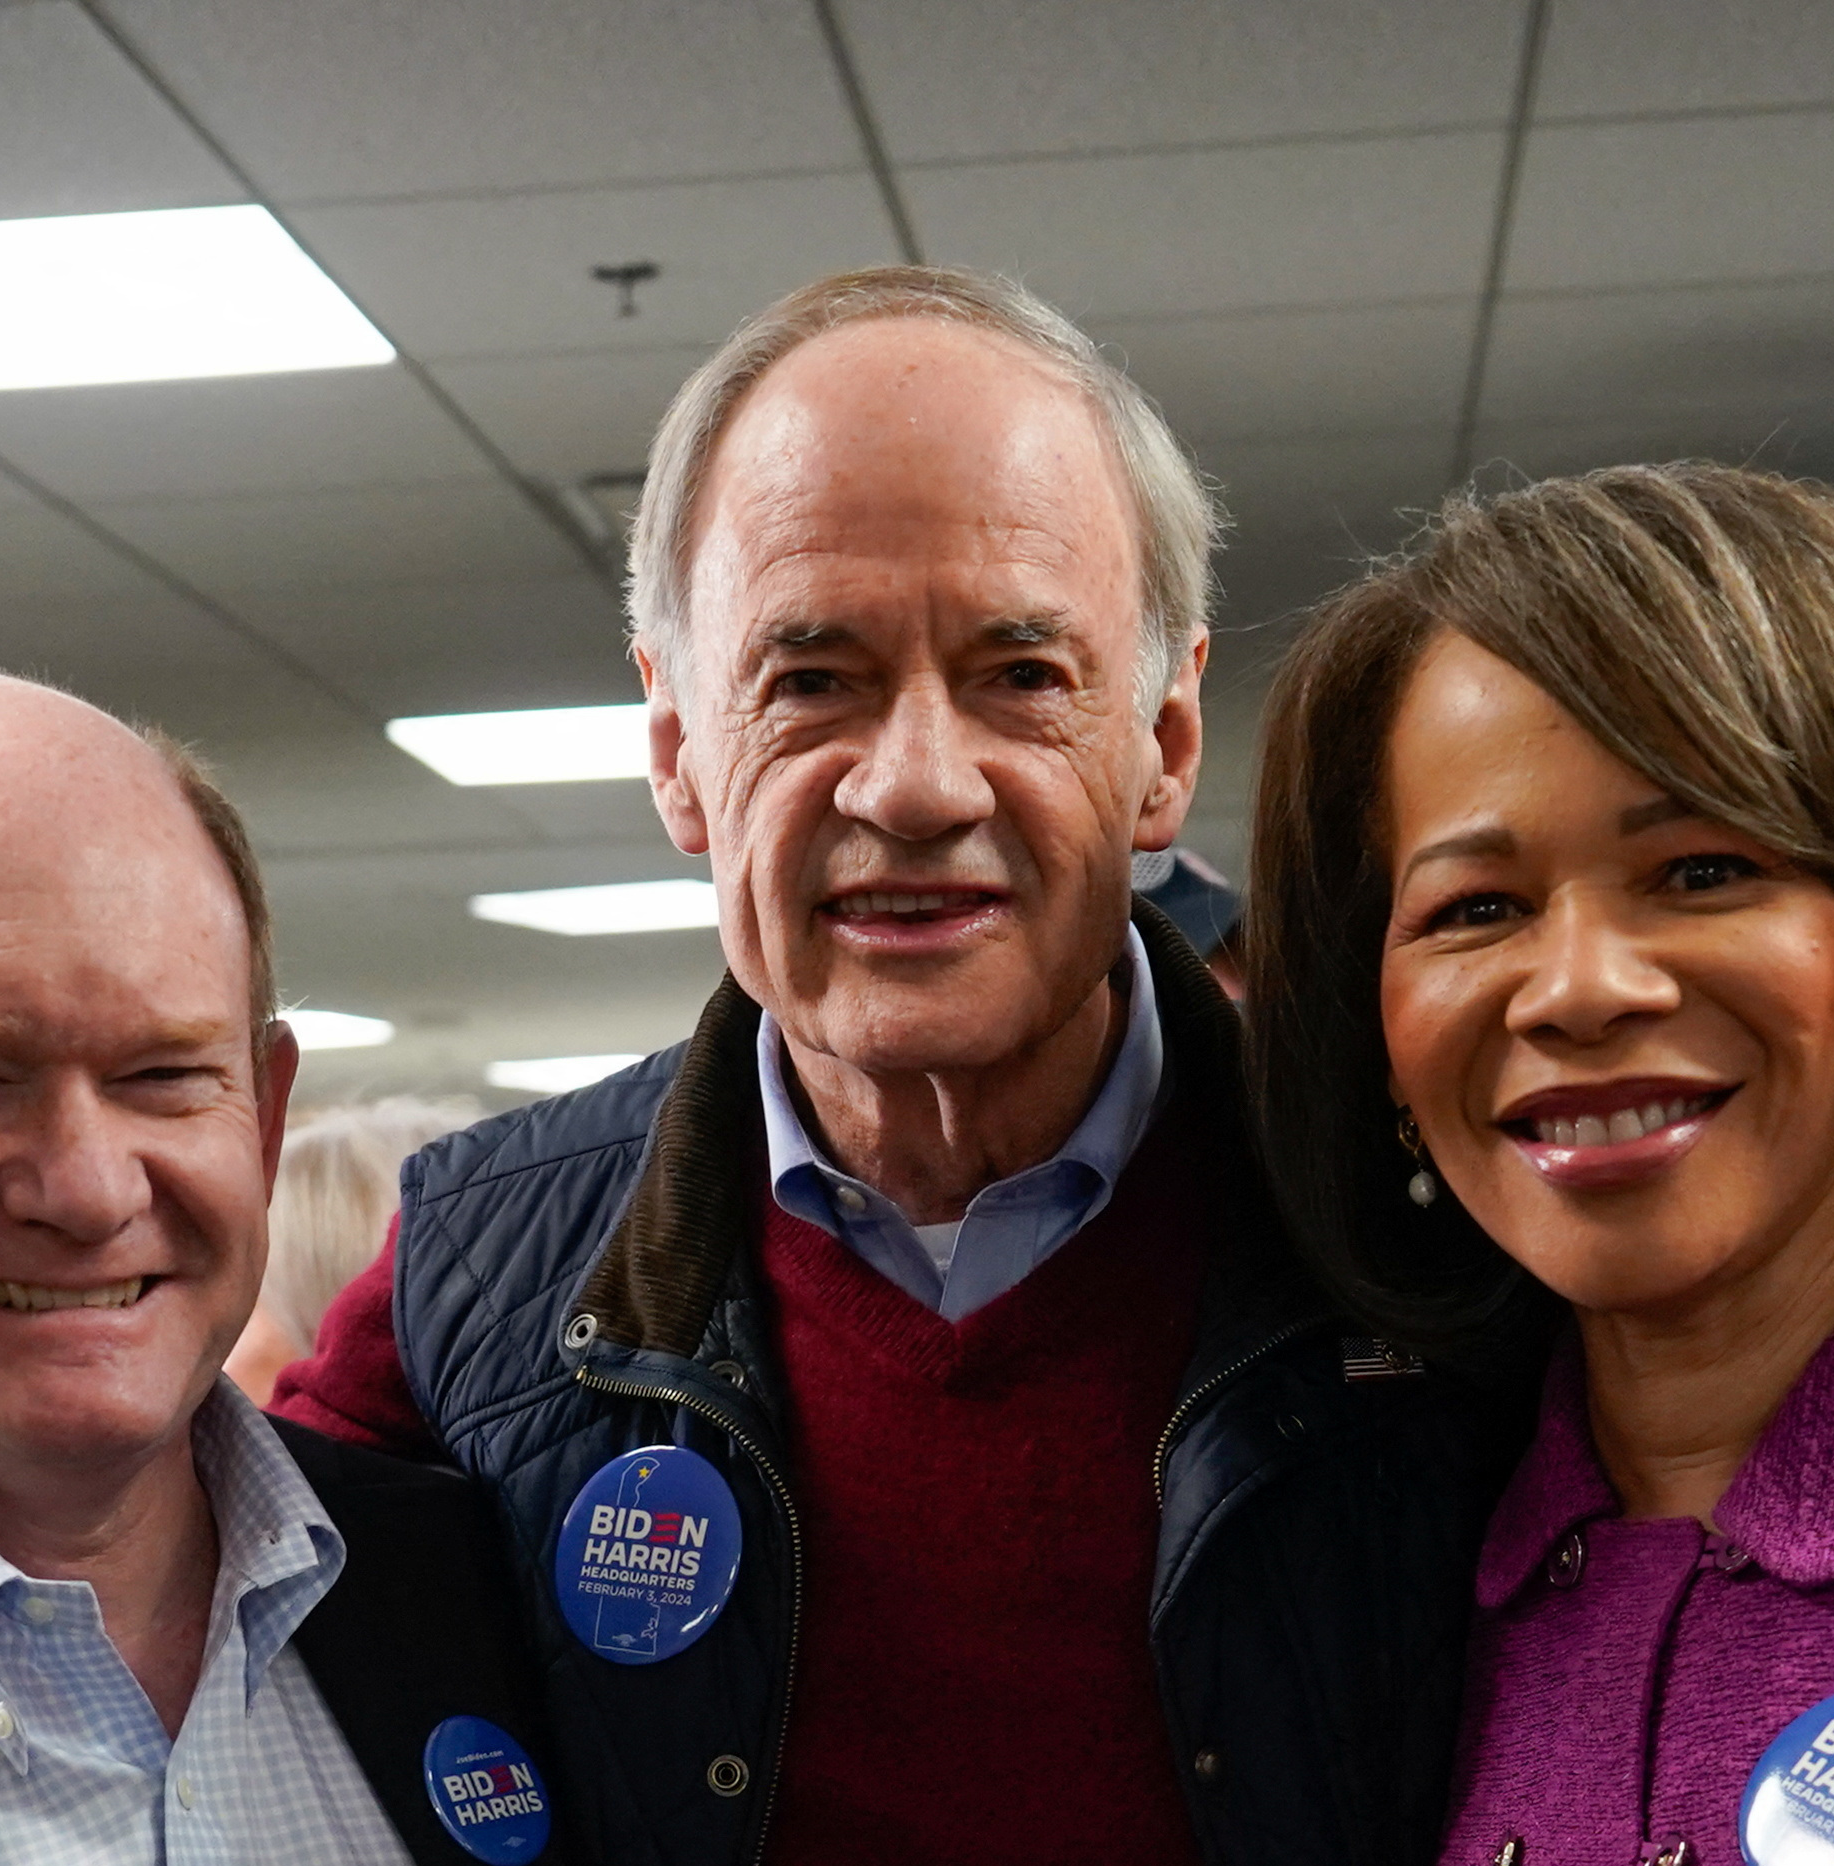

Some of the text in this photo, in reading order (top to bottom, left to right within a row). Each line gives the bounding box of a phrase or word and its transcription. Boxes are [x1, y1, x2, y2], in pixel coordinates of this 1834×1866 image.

[589, 1504, 709, 1548] BIDEN
[583, 1538, 701, 1576] HARRIS
[578, 1581, 692, 1606] FEBRUARY 3, 2024
[580, 1565, 696, 1592] HEADQUARTERS
[442, 1763, 535, 1802] BIDEN
[454, 1790, 544, 1826] HARRIS
